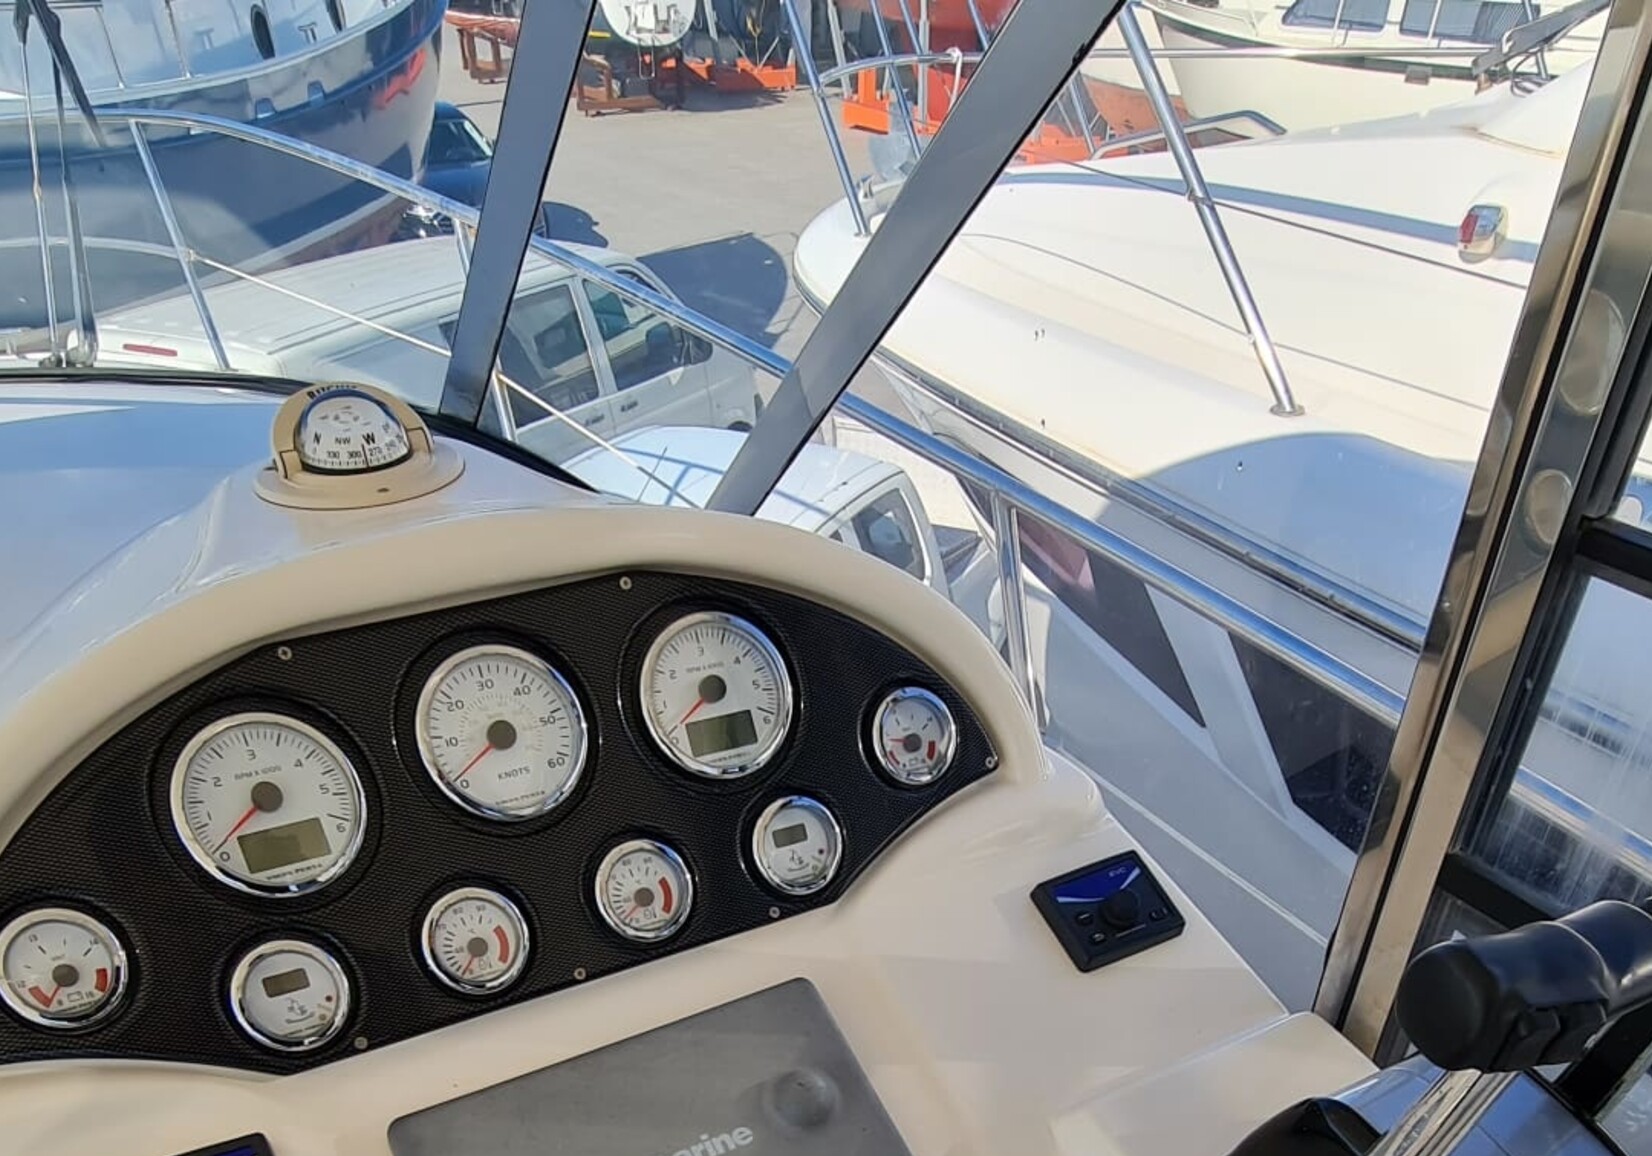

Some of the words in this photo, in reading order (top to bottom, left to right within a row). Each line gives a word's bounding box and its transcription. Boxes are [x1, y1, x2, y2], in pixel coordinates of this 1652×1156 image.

[313, 431, 322, 445] N
[335, 436, 351, 445] NW
[362, 432, 376, 446] W
[476, 678, 495, 692] 30
[513, 684, 532, 697] 40
[446, 700, 465, 713] 20
[539, 715, 557, 727] 50
[444, 736, 459, 748] 10
[547, 756, 566, 769] 60
[498, 765, 531, 780] KNOTS
[212, 776, 222, 788] 2
[459, 778, 470, 790] 0
[319, 783, 330, 795] 5
[336, 822, 346, 833] 6
[219, 851, 231, 863] 0
